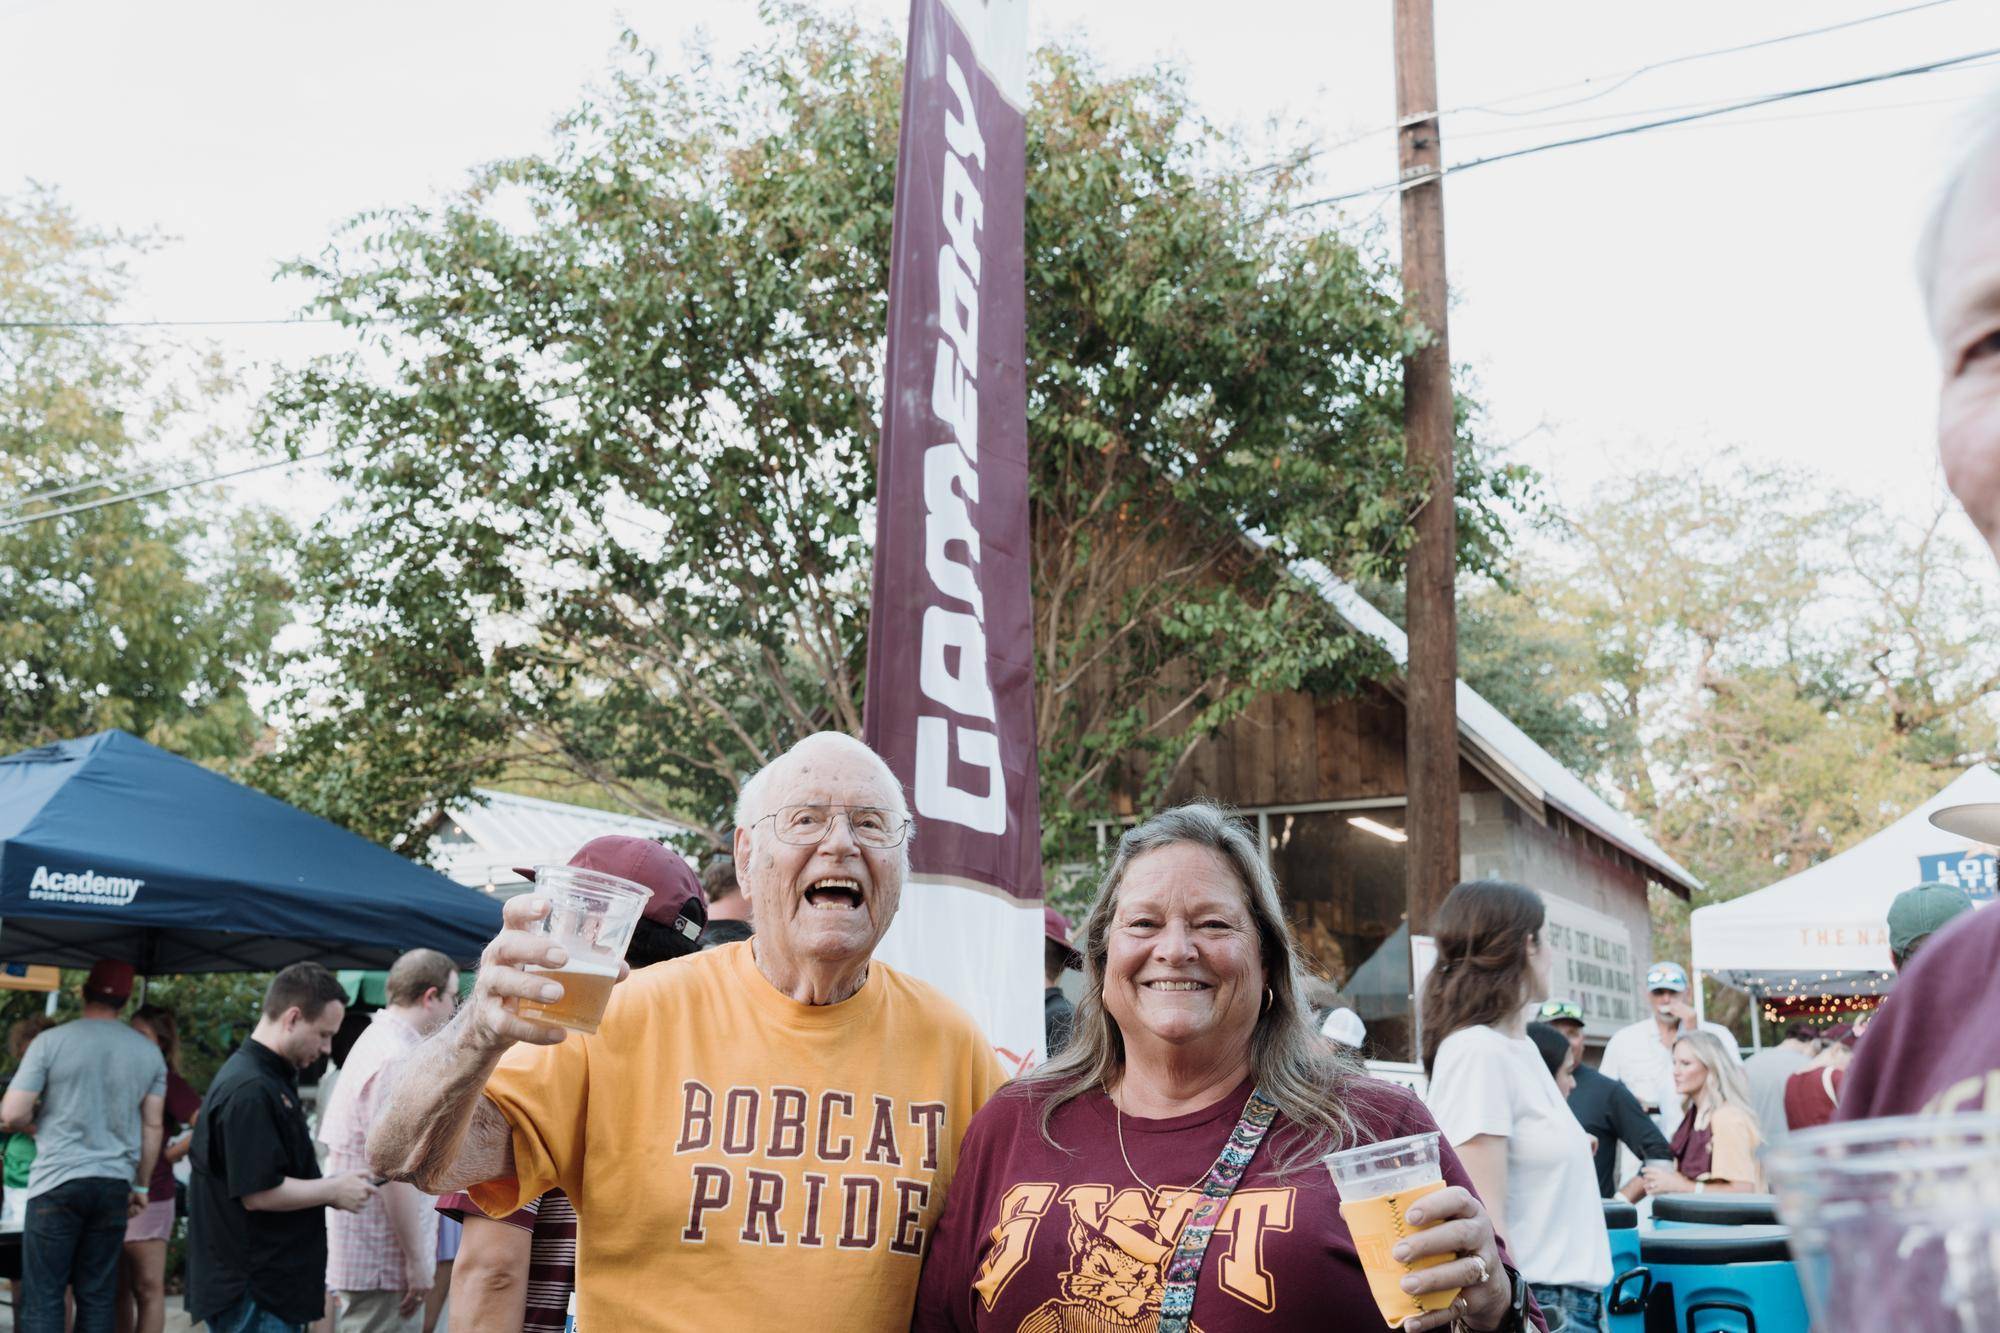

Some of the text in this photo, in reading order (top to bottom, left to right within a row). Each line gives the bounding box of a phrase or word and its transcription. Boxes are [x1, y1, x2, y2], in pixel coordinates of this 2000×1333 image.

[914, 53, 1007, 836] GAMEDAY
[30, 866, 140, 904] Academy
[1801, 929, 1847, 945] THE
[674, 1079, 946, 1170] BOBCAT
[681, 1163, 932, 1256] PRIDE
